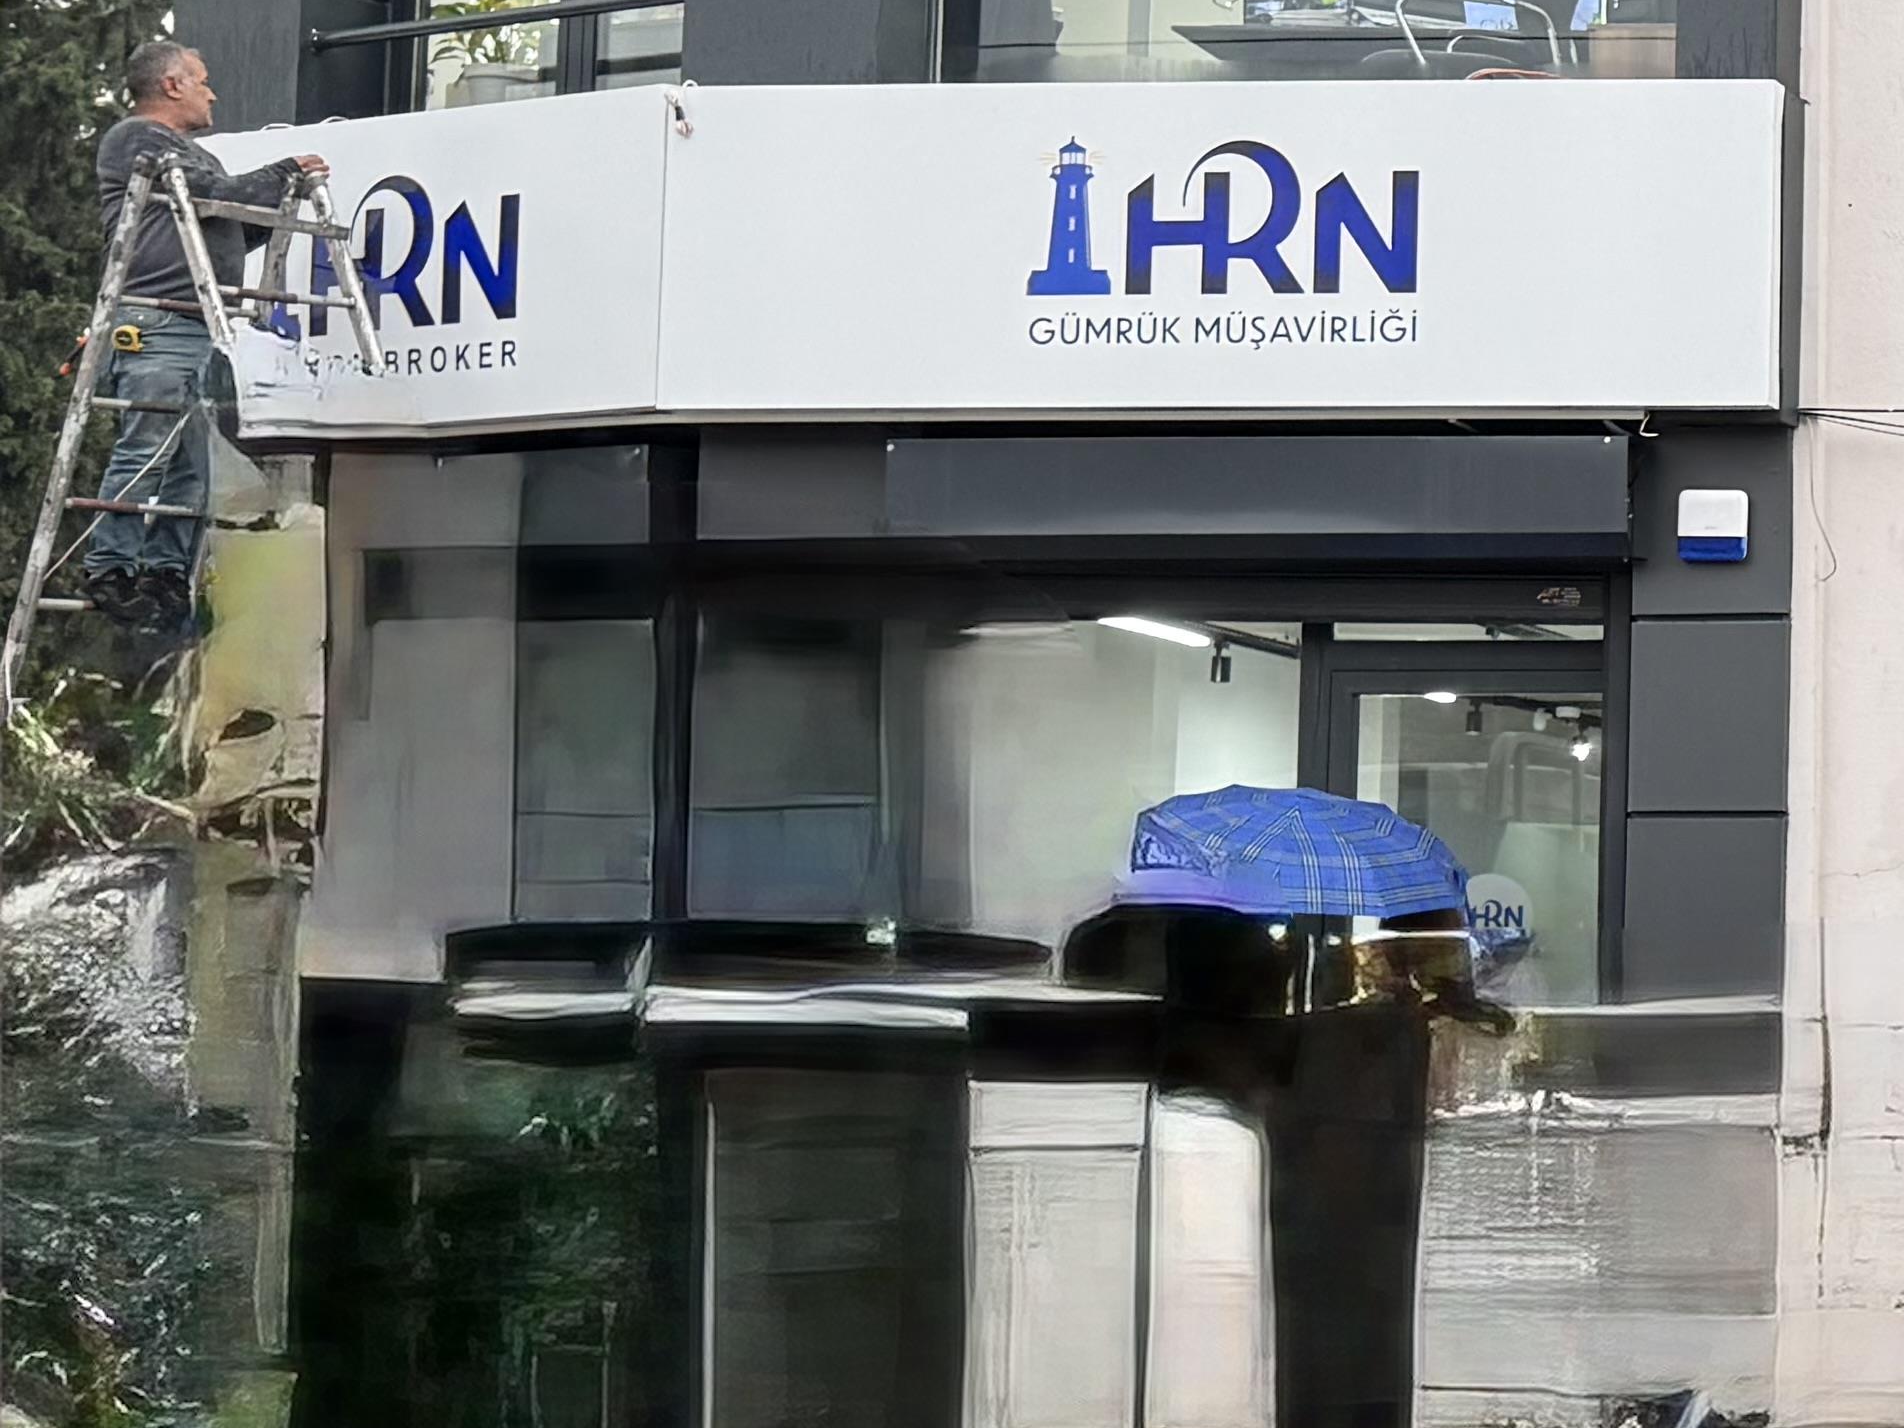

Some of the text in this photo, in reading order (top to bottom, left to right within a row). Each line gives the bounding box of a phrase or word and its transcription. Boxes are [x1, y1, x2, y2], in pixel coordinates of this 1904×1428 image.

[1125, 140, 1420, 295] HRN
[1028, 308, 1418, 351] GÜMRÜK MÜŞAVİRLİĞİ
